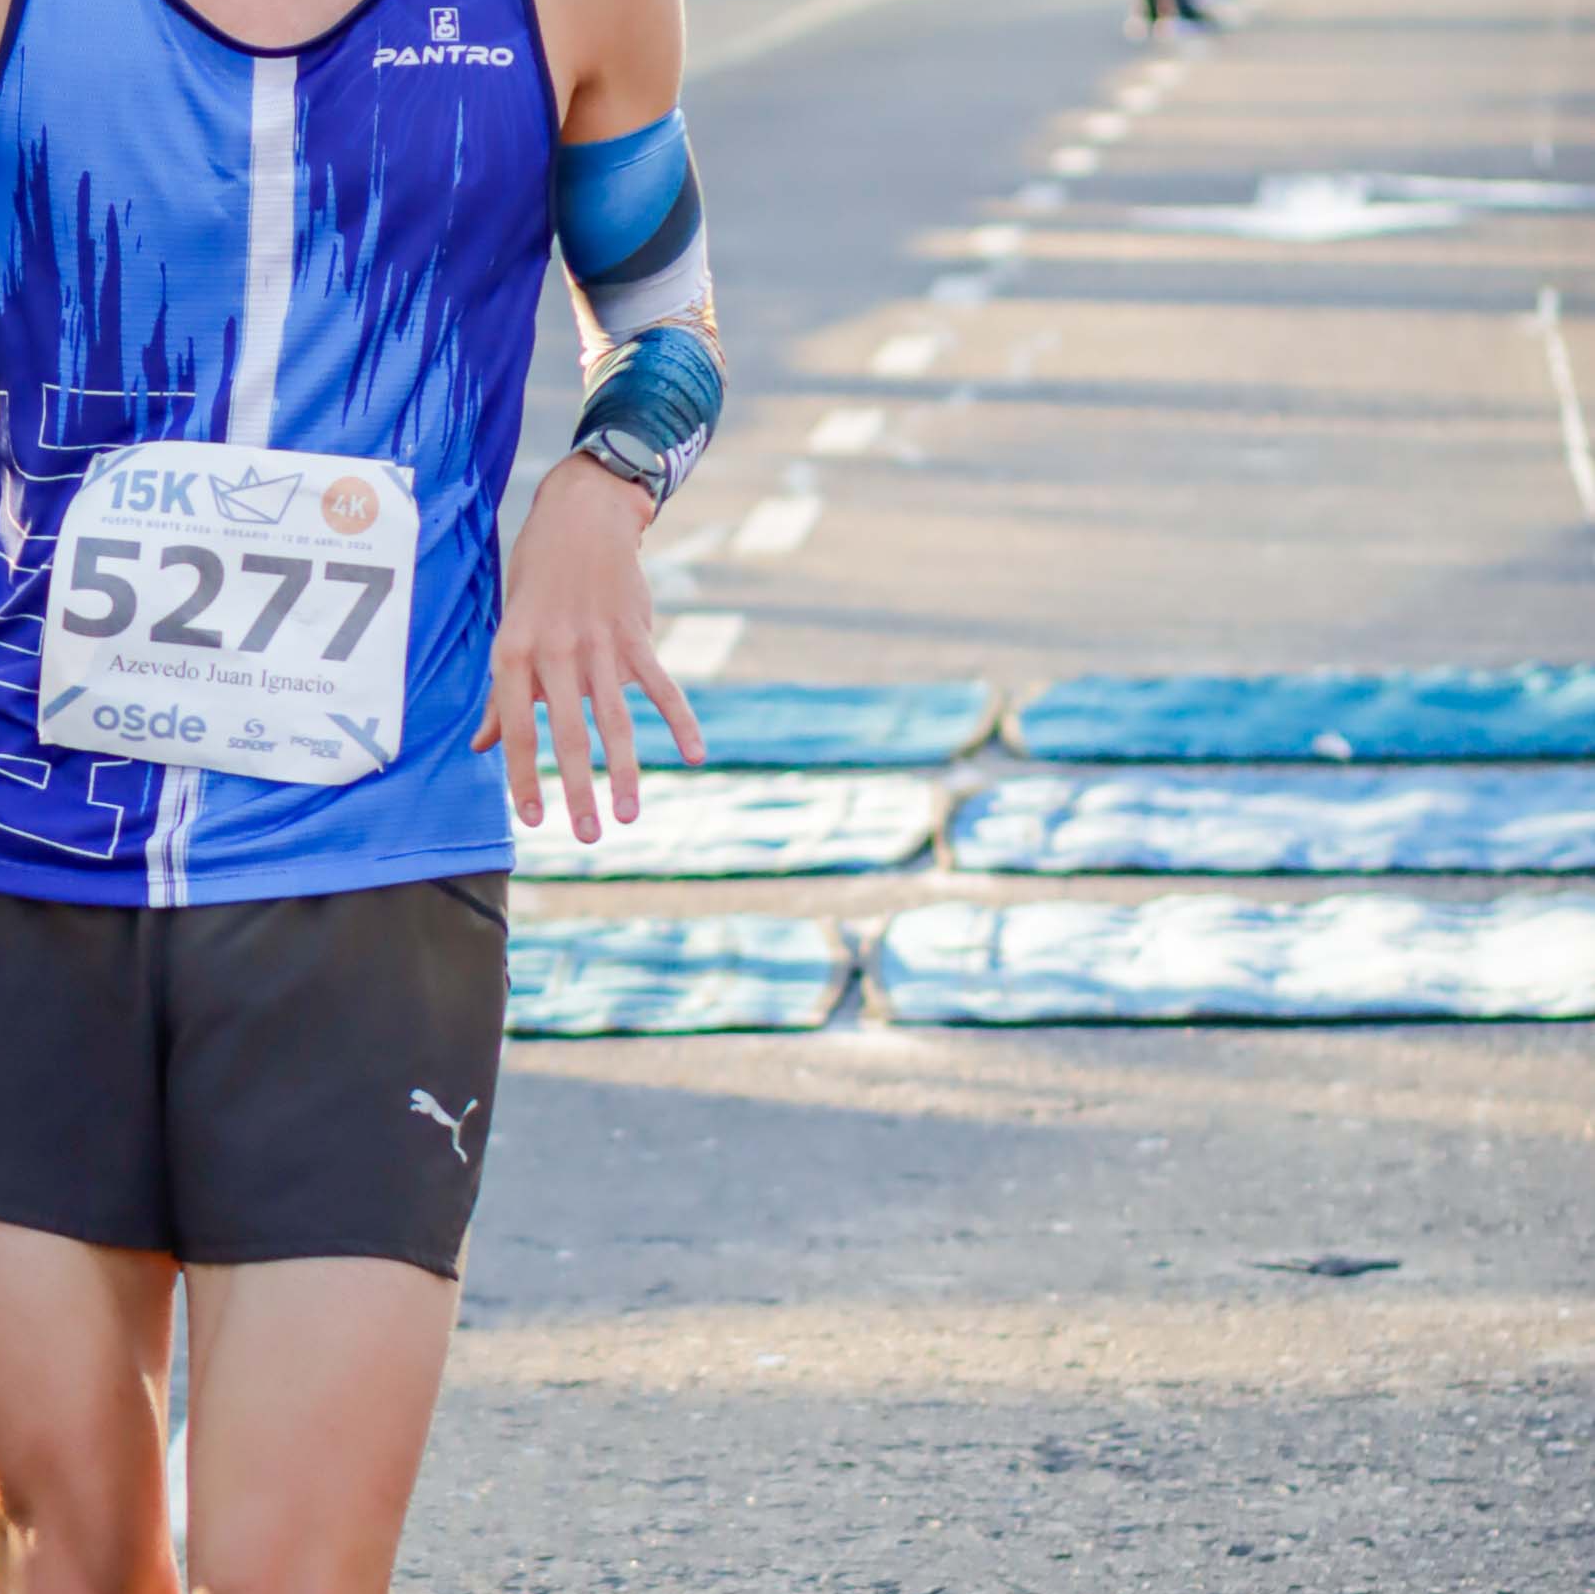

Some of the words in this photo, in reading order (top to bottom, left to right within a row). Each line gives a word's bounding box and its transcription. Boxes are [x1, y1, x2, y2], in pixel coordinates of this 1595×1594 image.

[372, 45, 515, 68] PANTRO
[109, 469, 200, 517] 15K
[331, 492, 368, 519] 4K
[62, 536, 395, 663] 5277
[109, 654, 199, 680] Azevedo
[206, 663, 253, 686] Juan
[261, 669, 335, 694] Ignacio
[93, 703, 207, 743] osde
